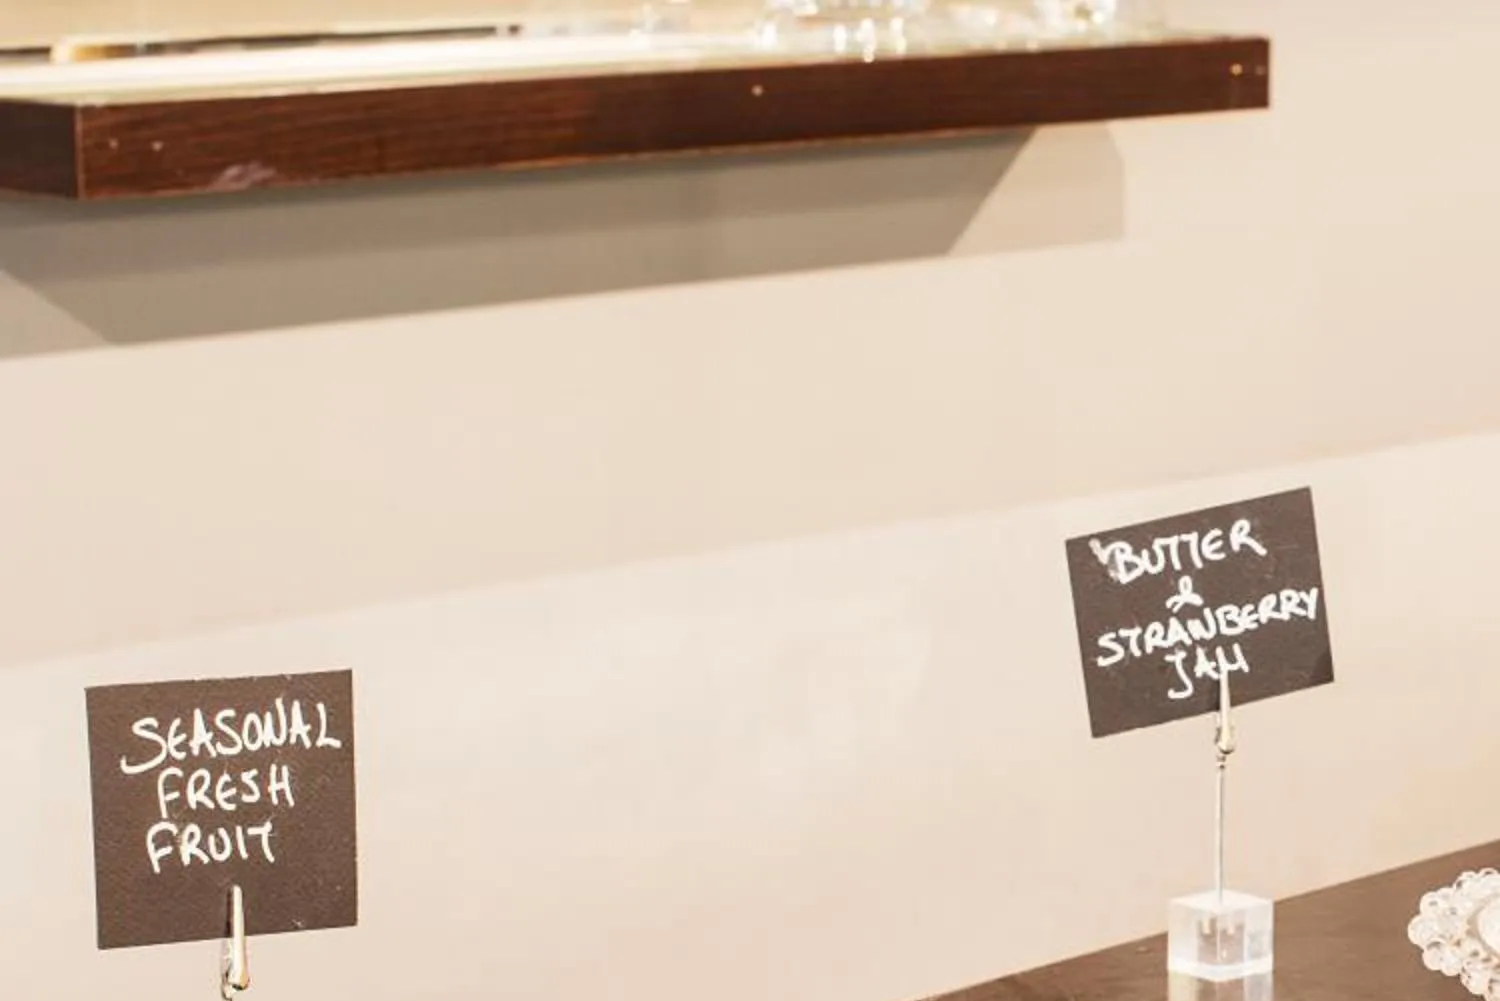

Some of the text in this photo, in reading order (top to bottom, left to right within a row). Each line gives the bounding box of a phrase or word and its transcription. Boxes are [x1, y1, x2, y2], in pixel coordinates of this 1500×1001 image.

[1088, 518, 1268, 585] BUTTER
[1165, 575, 1204, 613] &
[1096, 587, 1319, 668] STRAWBERRY
[1164, 642, 1250, 700] JAM
[119, 696, 342, 775] SEASONAL
[157, 763, 295, 819] FRESH
[145, 820, 276, 874] FRUIT
